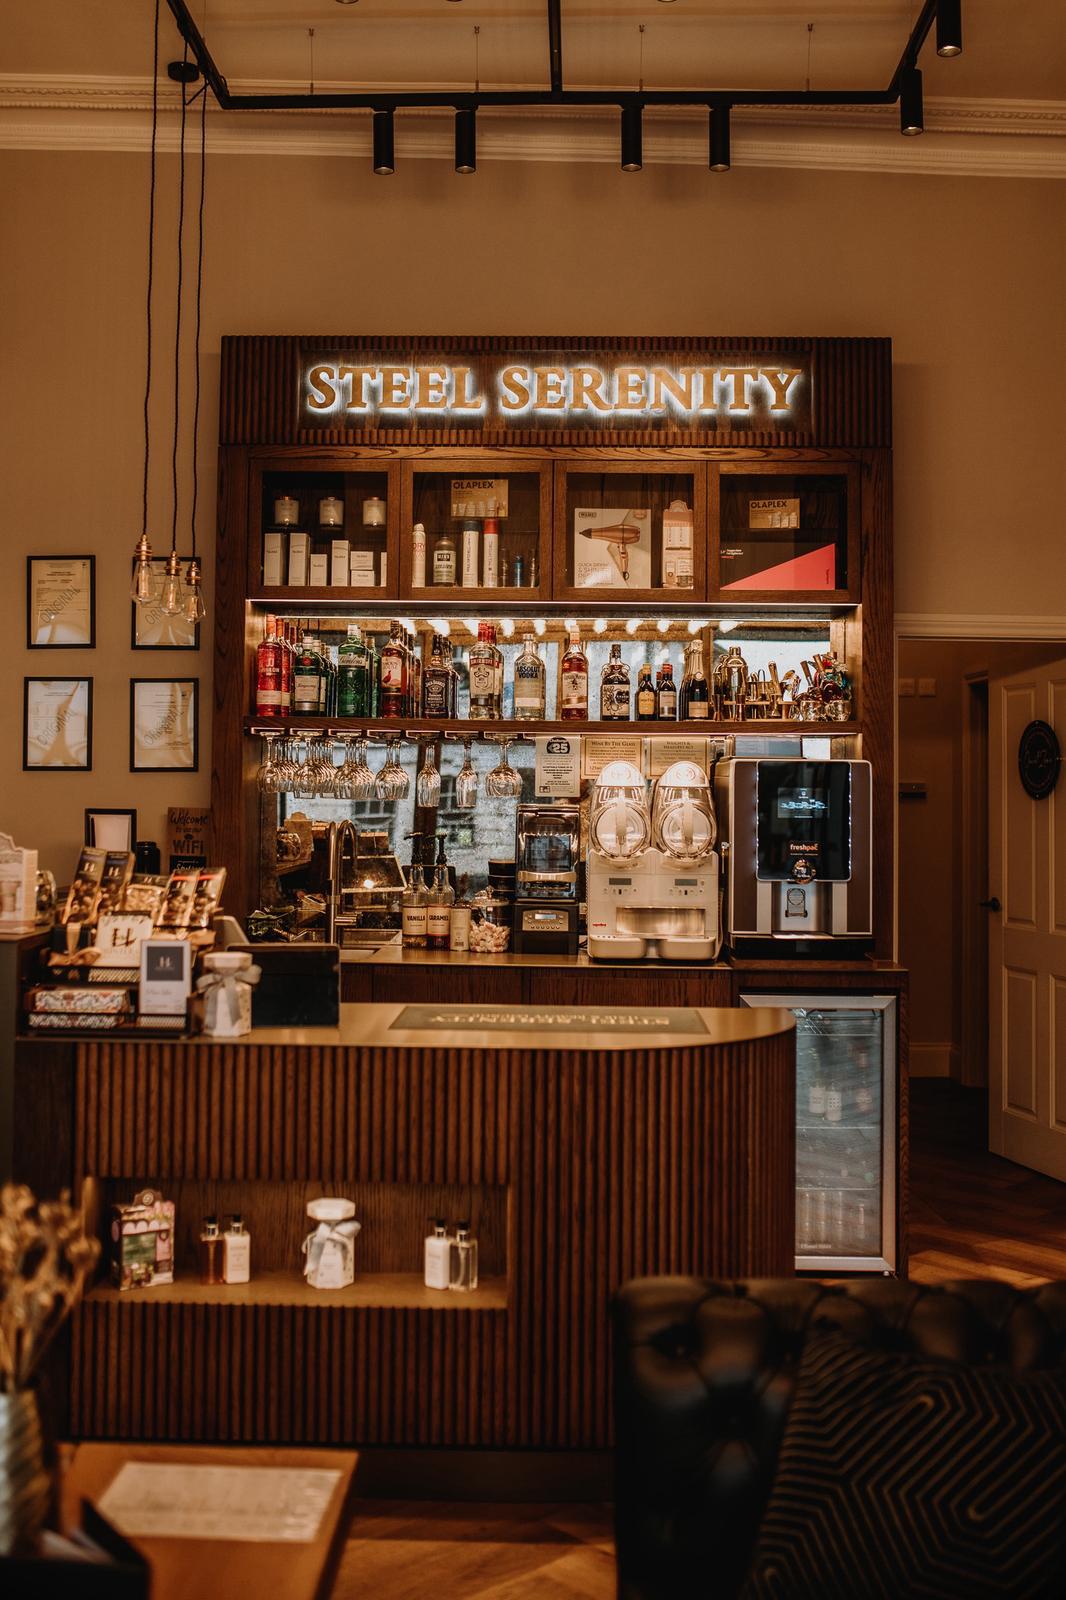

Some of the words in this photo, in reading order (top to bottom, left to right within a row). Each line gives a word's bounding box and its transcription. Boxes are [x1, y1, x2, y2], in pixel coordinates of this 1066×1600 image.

[307, 365, 482, 410] STEEL
[501, 365, 802, 411] SERENITY
[453, 481, 494, 489] OLAPLEX
[750, 500, 788, 509] OLAPLEX
[516, 665, 540, 673] ABSOLUT
[552, 743, 568, 753] 25
